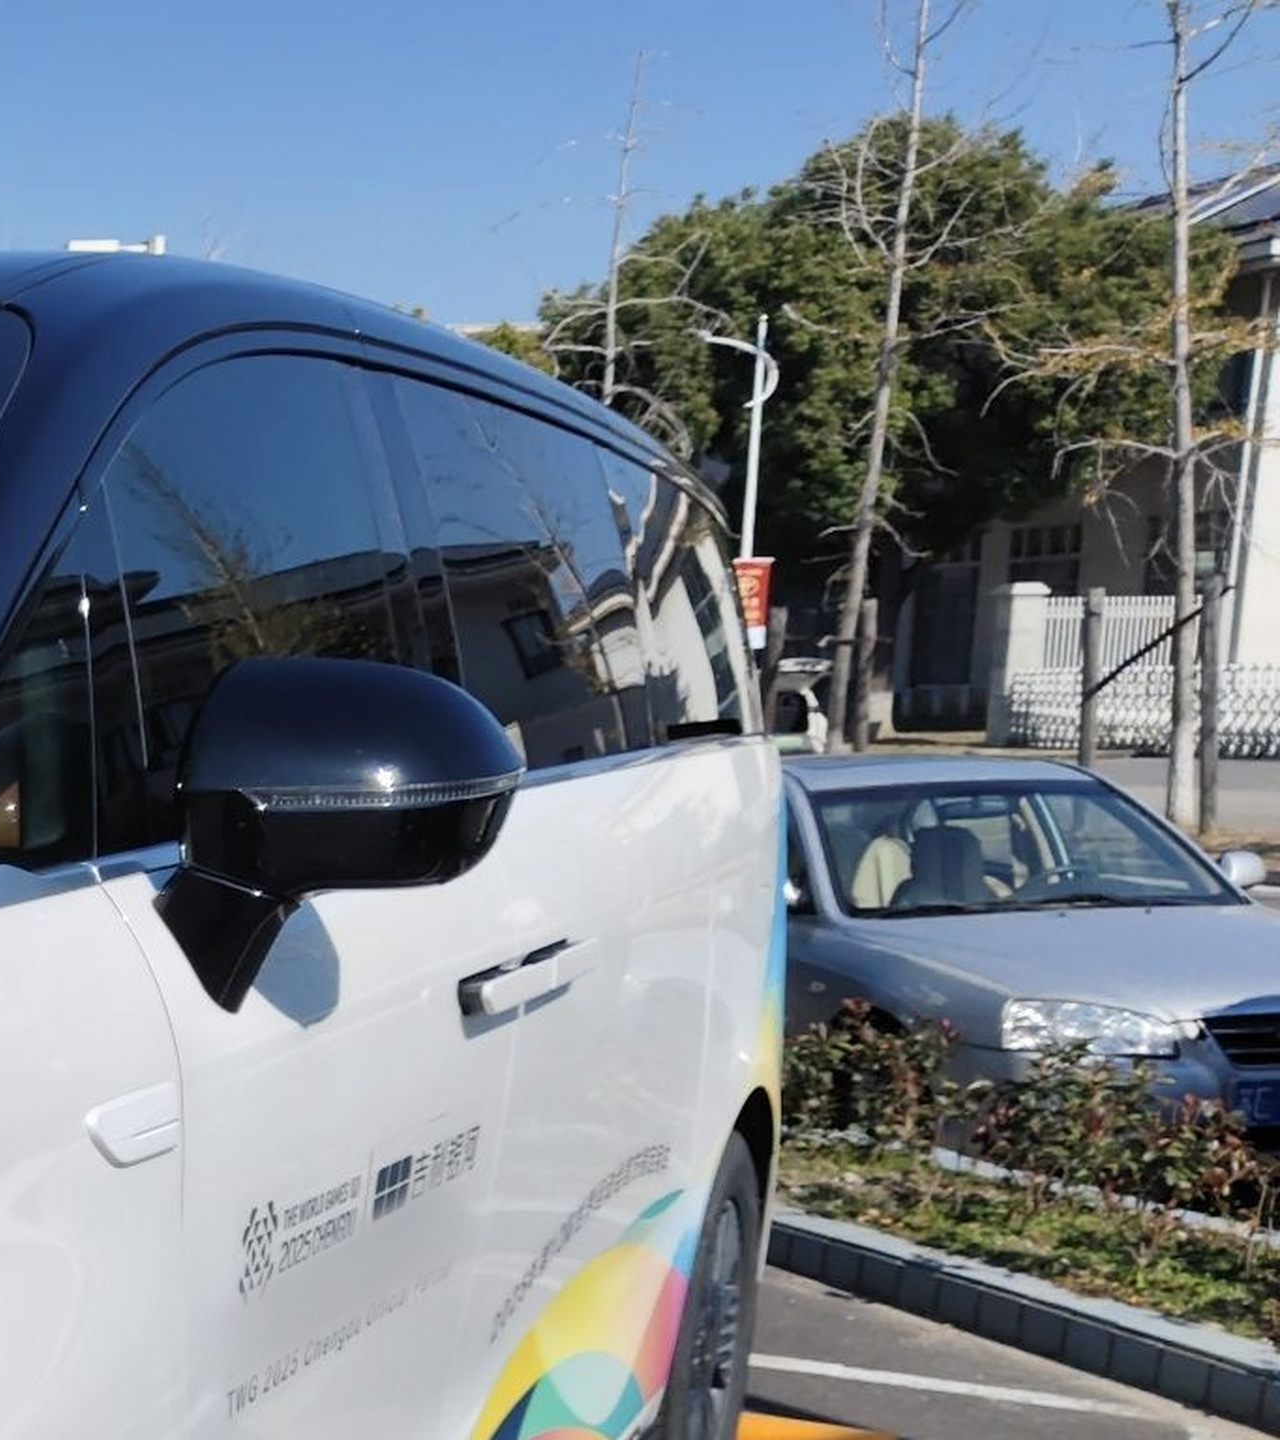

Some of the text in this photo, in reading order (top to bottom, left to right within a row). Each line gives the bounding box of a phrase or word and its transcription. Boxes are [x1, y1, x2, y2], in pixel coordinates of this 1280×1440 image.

[278, 1228, 312, 1273] 2025
[227, 1373, 259, 1419] TWG
[263, 1350, 300, 1394] 2025
